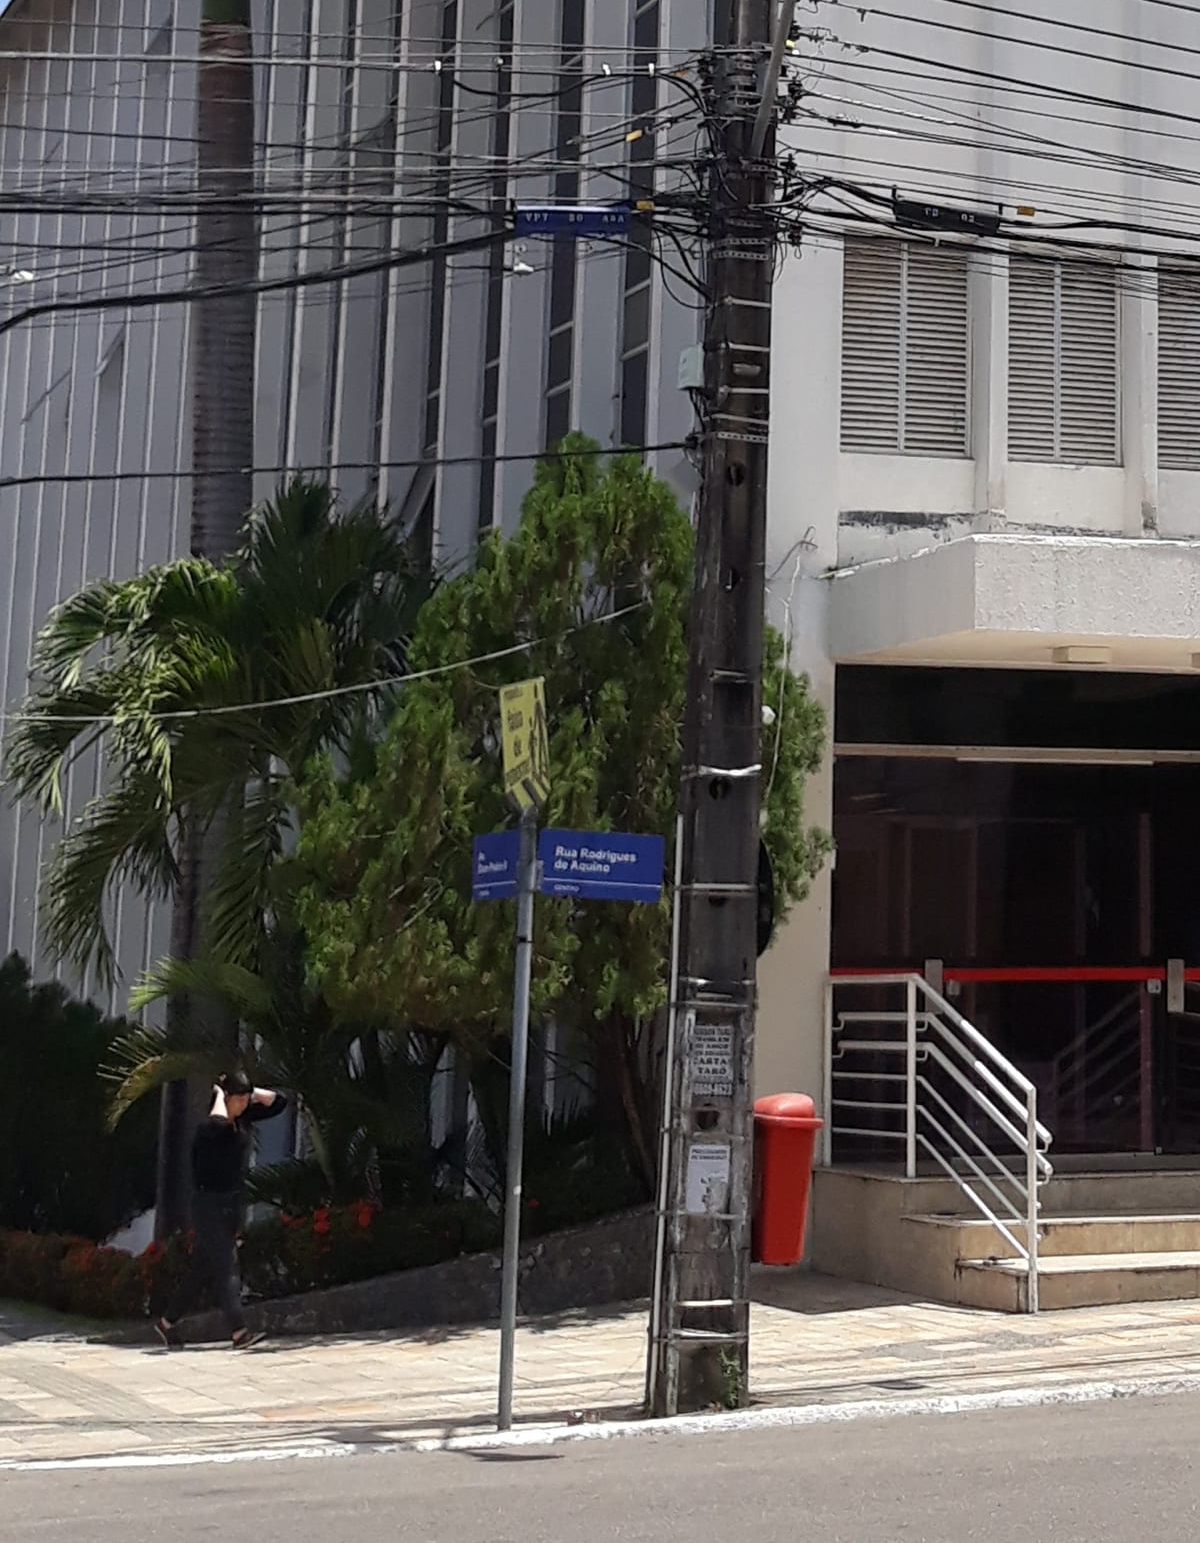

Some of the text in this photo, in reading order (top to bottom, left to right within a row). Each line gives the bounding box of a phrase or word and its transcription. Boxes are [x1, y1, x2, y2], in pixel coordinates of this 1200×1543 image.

[555, 845, 637, 863] Rua Rodrigues
[554, 860, 610, 873] de Aquino
